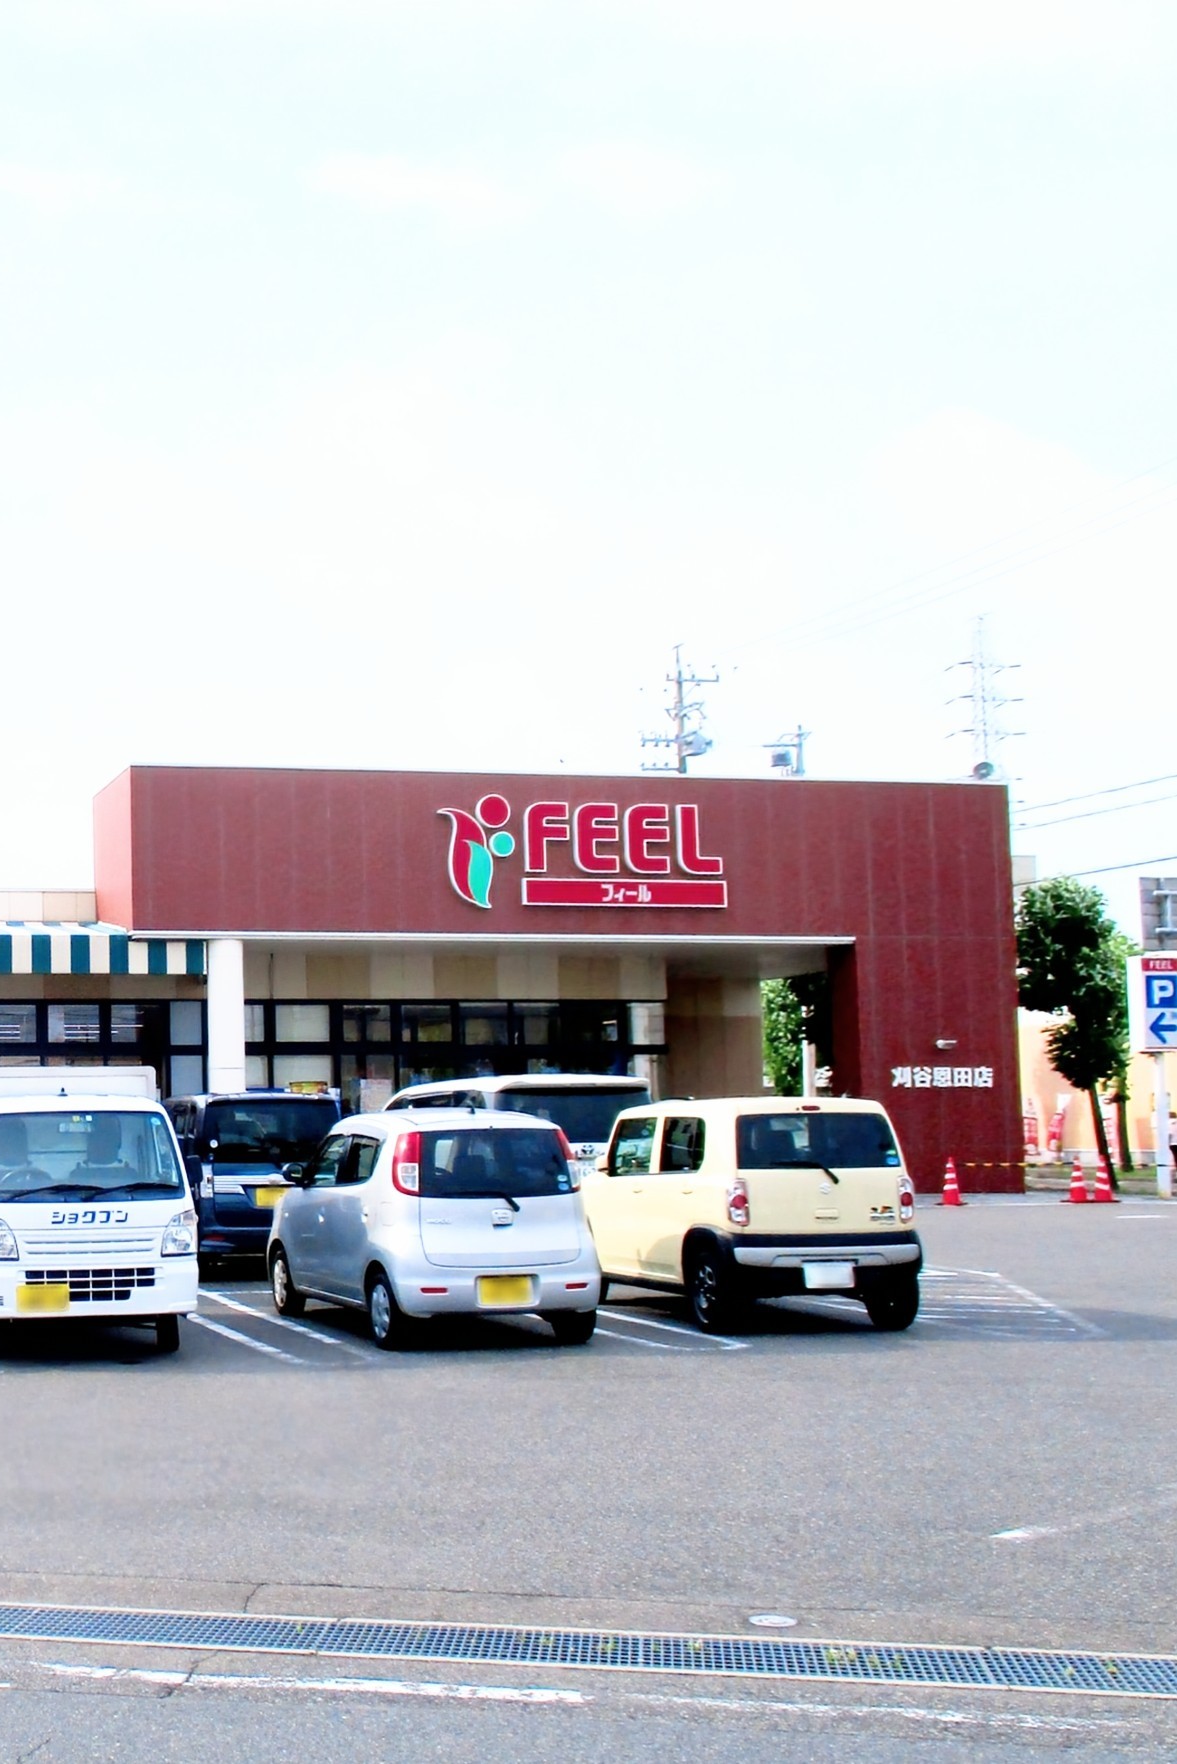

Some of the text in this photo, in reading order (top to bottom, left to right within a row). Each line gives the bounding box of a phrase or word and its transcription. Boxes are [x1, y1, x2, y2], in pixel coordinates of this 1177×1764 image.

[524, 801, 724, 874] FEEL
[600, 884, 652, 903] フィール
[1149, 960, 1173, 970] FEEL
[1153, 979, 1174, 1005] P
[891, 1066, 993, 1088] 刈谷恩田店
